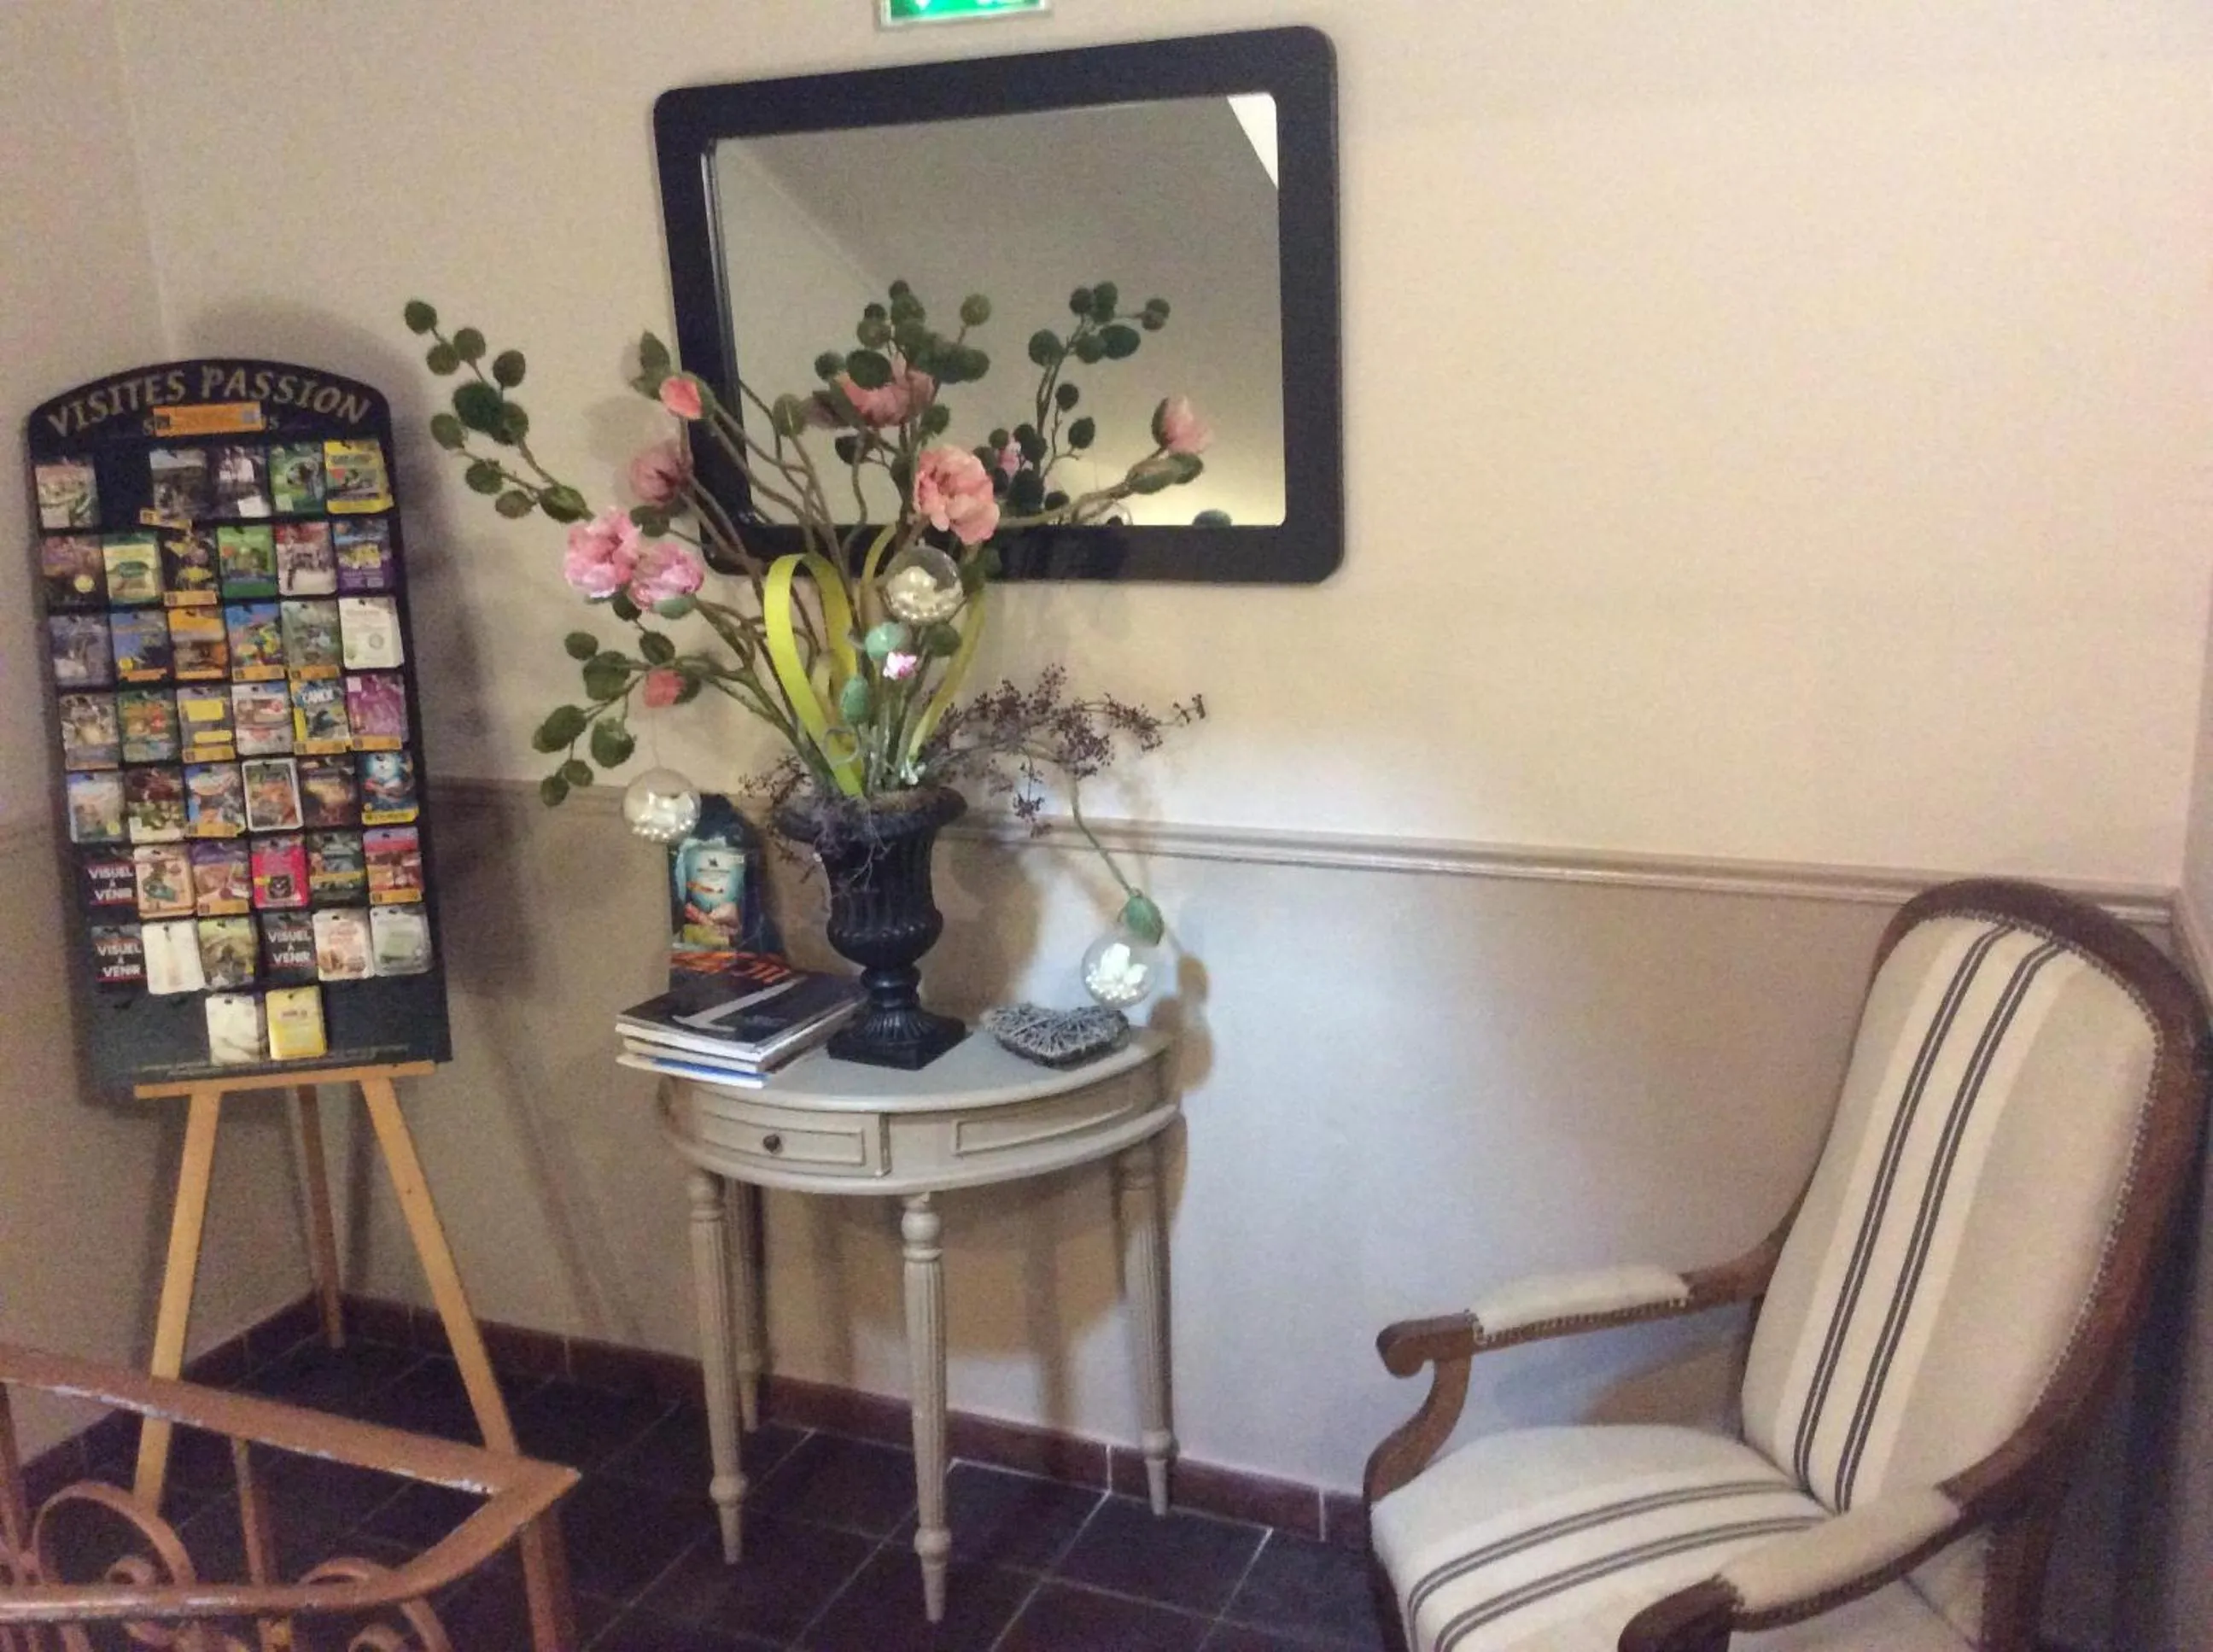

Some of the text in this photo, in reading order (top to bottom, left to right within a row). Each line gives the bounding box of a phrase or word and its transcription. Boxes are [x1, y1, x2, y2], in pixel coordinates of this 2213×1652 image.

[47, 365, 371, 437] VISITES PASSION
[87, 865, 134, 879] VISUEL
[266, 930, 312, 943] VISUEL
[95, 942, 142, 956] VISUEL
[272, 951, 311, 965] VENIR
[102, 964, 141, 978] VENIR
